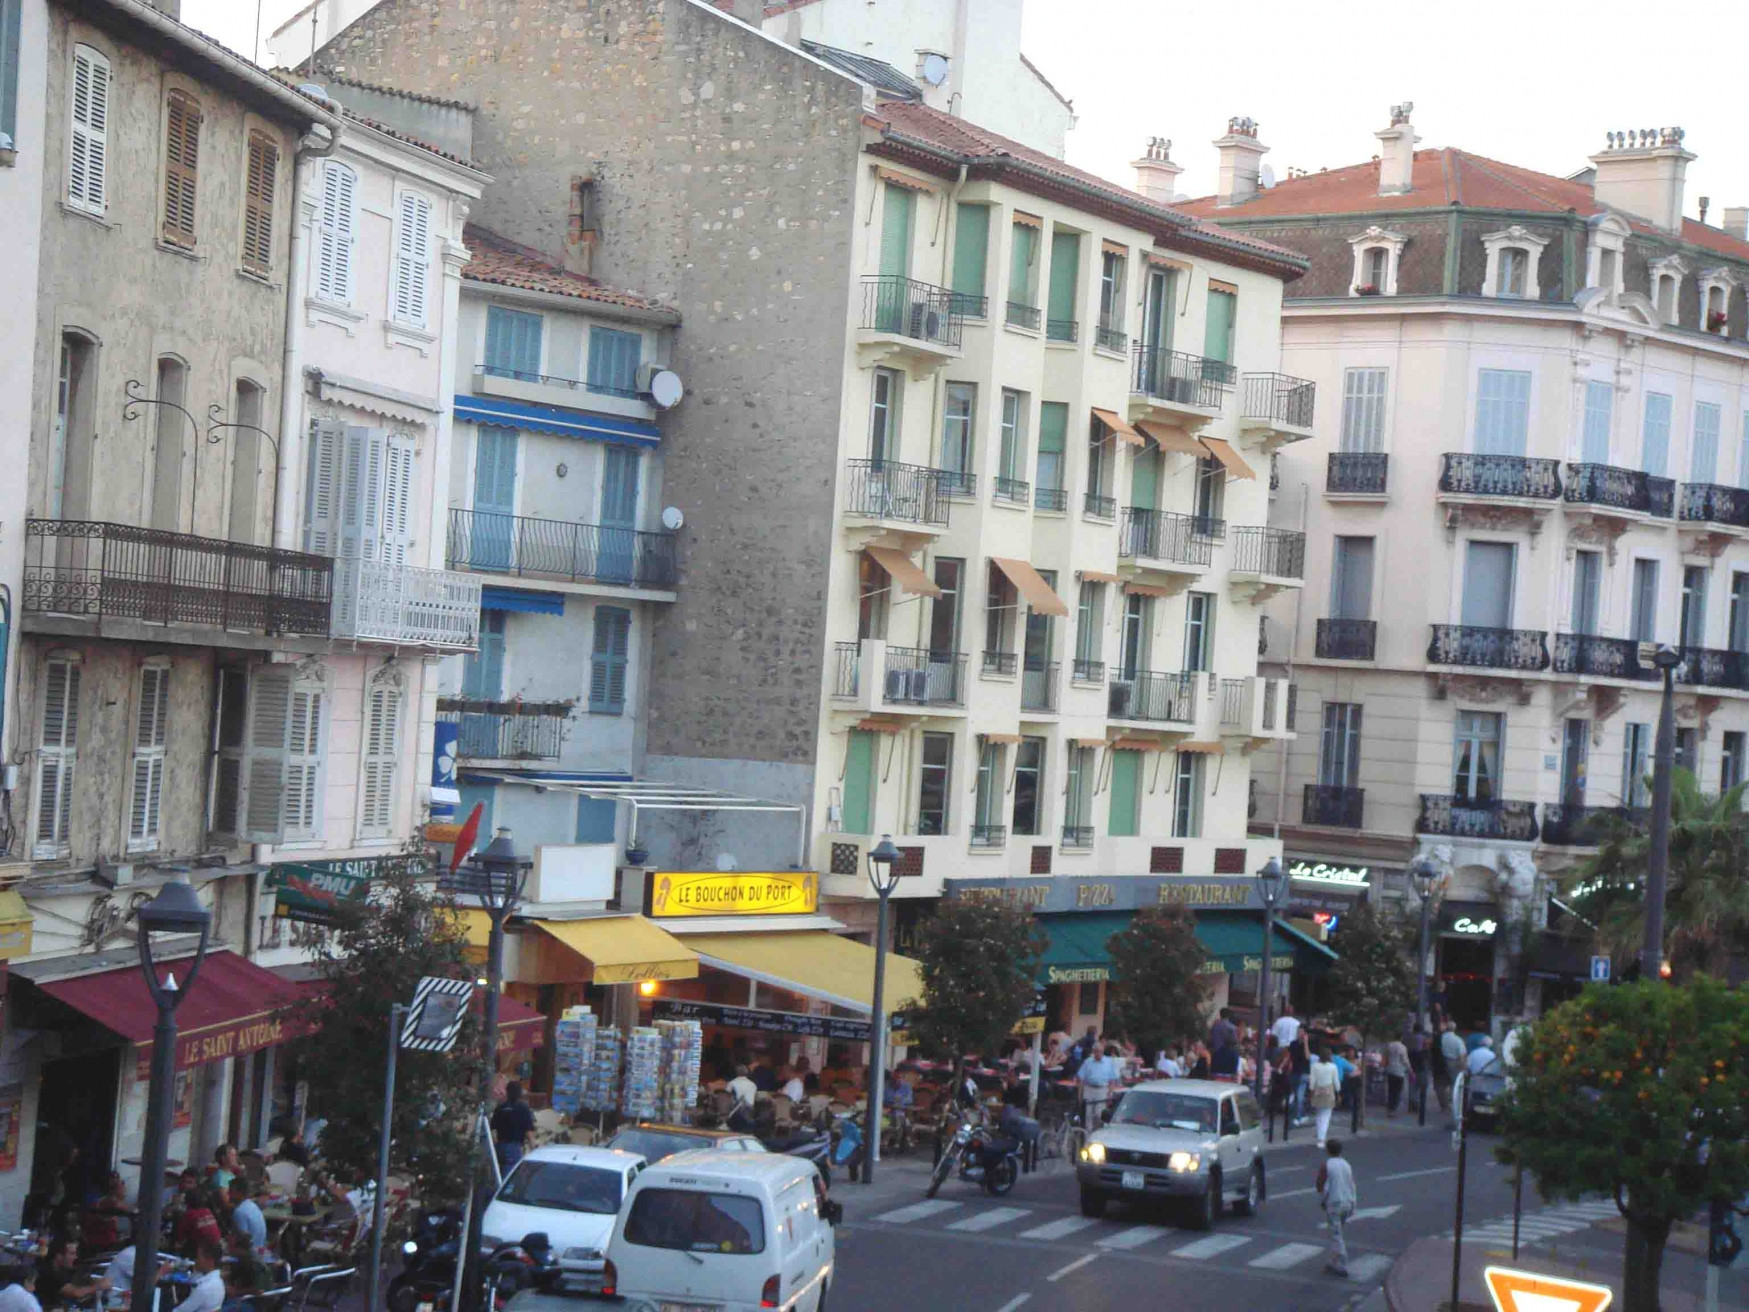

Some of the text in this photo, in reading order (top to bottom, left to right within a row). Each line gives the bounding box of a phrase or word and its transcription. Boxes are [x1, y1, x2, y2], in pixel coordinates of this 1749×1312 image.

[310, 872, 357, 895] PMU
[679, 885, 793, 903] LE BOUCHON DU PORT
[1157, 884, 1252, 905] RESTAURANT
[183, 1042, 199, 1064] LE
[202, 1031, 235, 1058] SAINT
